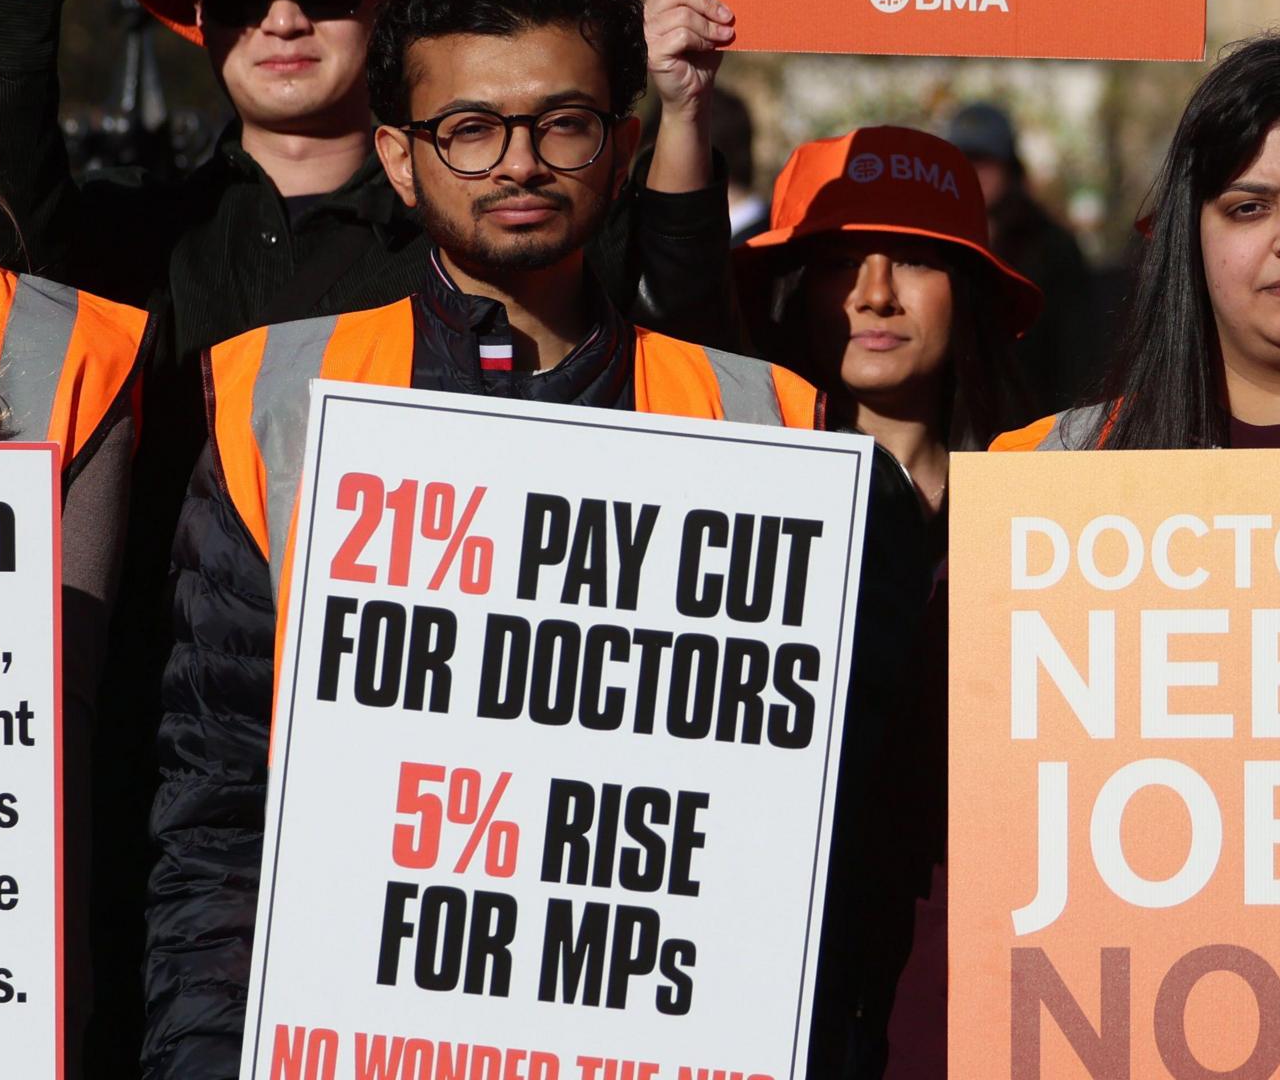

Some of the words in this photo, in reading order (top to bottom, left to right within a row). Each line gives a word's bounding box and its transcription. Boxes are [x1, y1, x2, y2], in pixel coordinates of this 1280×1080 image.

[890, 153, 960, 200] BMA
[329, 471, 495, 595] 21%
[516, 492, 660, 611] PAY
[675, 508, 824, 627] CUT
[316, 595, 458, 714] FOR
[476, 612, 820, 750] DOCTORS
[391, 761, 519, 878] 5%
[539, 777, 710, 897] RISE
[376, 881, 517, 998] FOR
[537, 898, 697, 1016] MPs
[270, 1024, 339, 1080] NO
